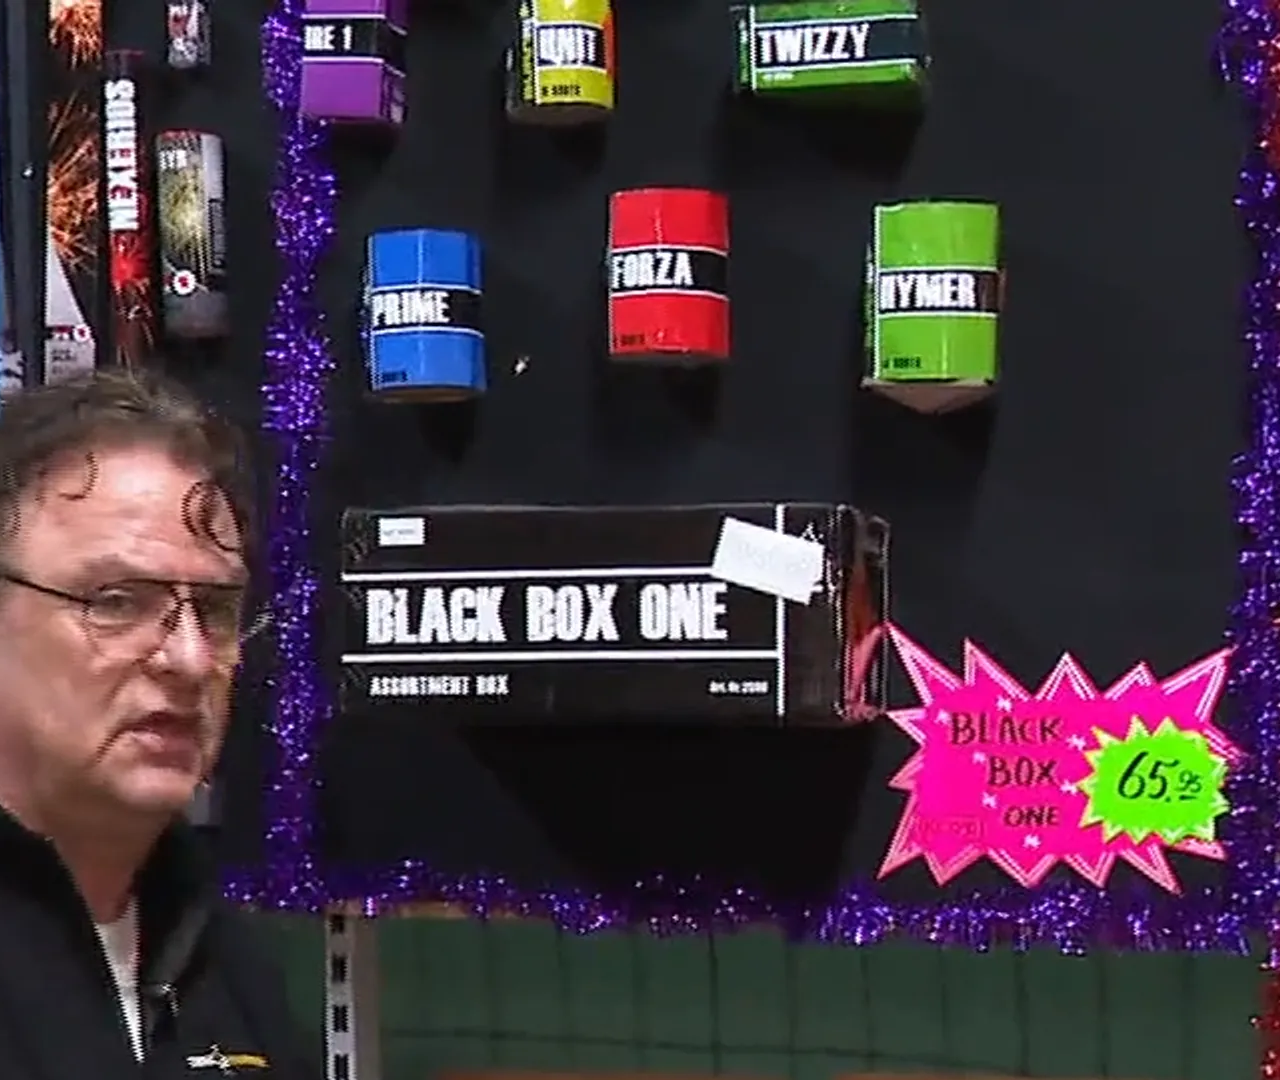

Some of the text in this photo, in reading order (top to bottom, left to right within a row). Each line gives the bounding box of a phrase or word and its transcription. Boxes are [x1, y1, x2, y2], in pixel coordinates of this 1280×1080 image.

[539, 27, 598, 64] UNIT
[757, 23, 870, 63] TWIZZY
[610, 250, 694, 291] FORZA
[371, 290, 451, 326] PRIME
[366, 582, 728, 645] BLACK BOX ONE
[369, 674, 510, 698] ASSORTMENT BOX
[949, 711, 1062, 746] BLACK
[986, 755, 1059, 788] BOX
[1003, 803, 1061, 828] ONE
